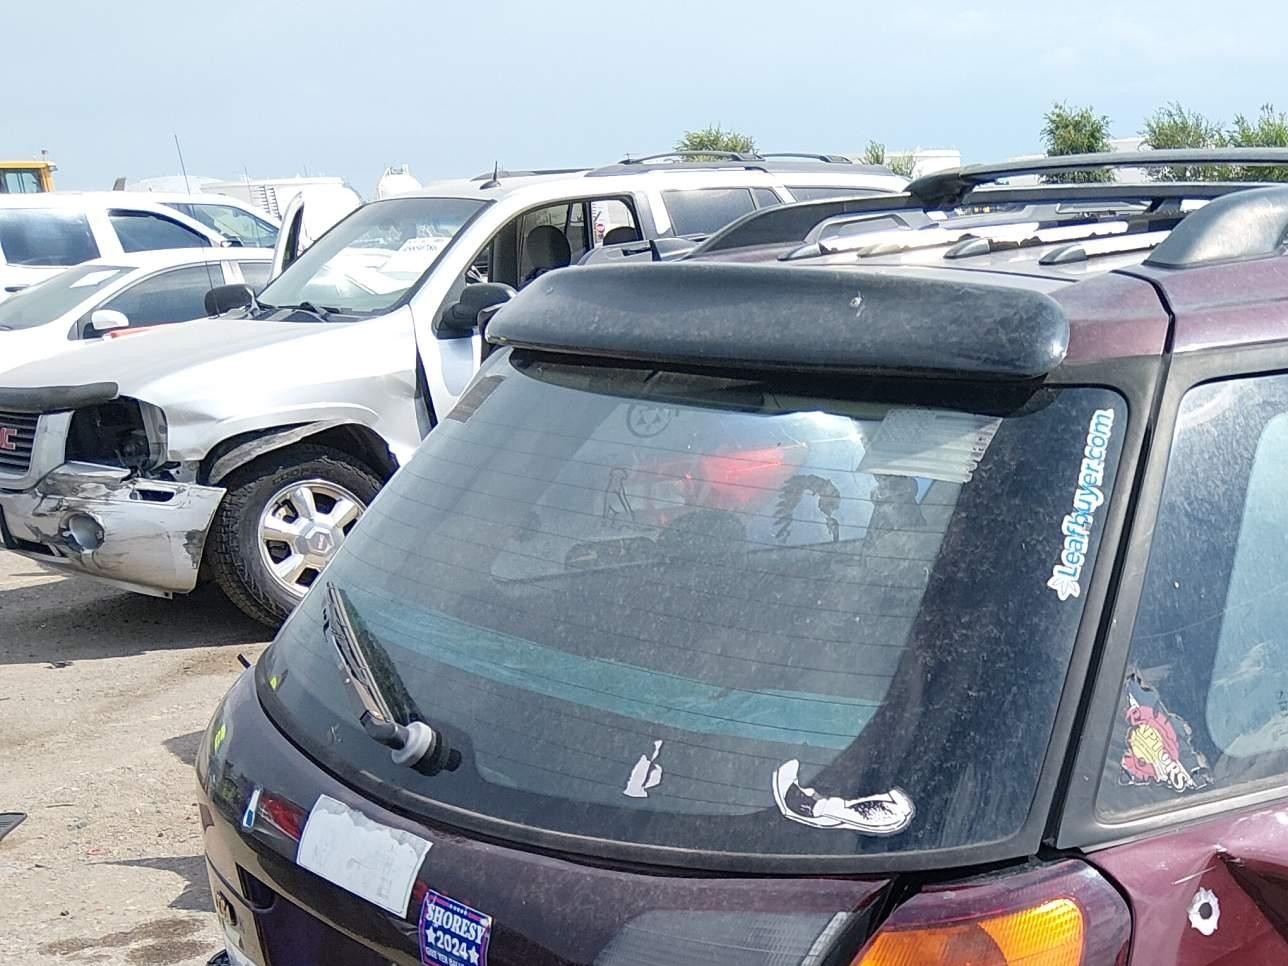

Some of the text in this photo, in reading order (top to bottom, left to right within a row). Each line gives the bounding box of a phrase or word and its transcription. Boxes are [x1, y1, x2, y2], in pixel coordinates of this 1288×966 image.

[1055, 411, 1113, 579] Leafbuyer.com
[426, 903, 486, 944] SHORESY
[436, 930, 469, 960] 2024
